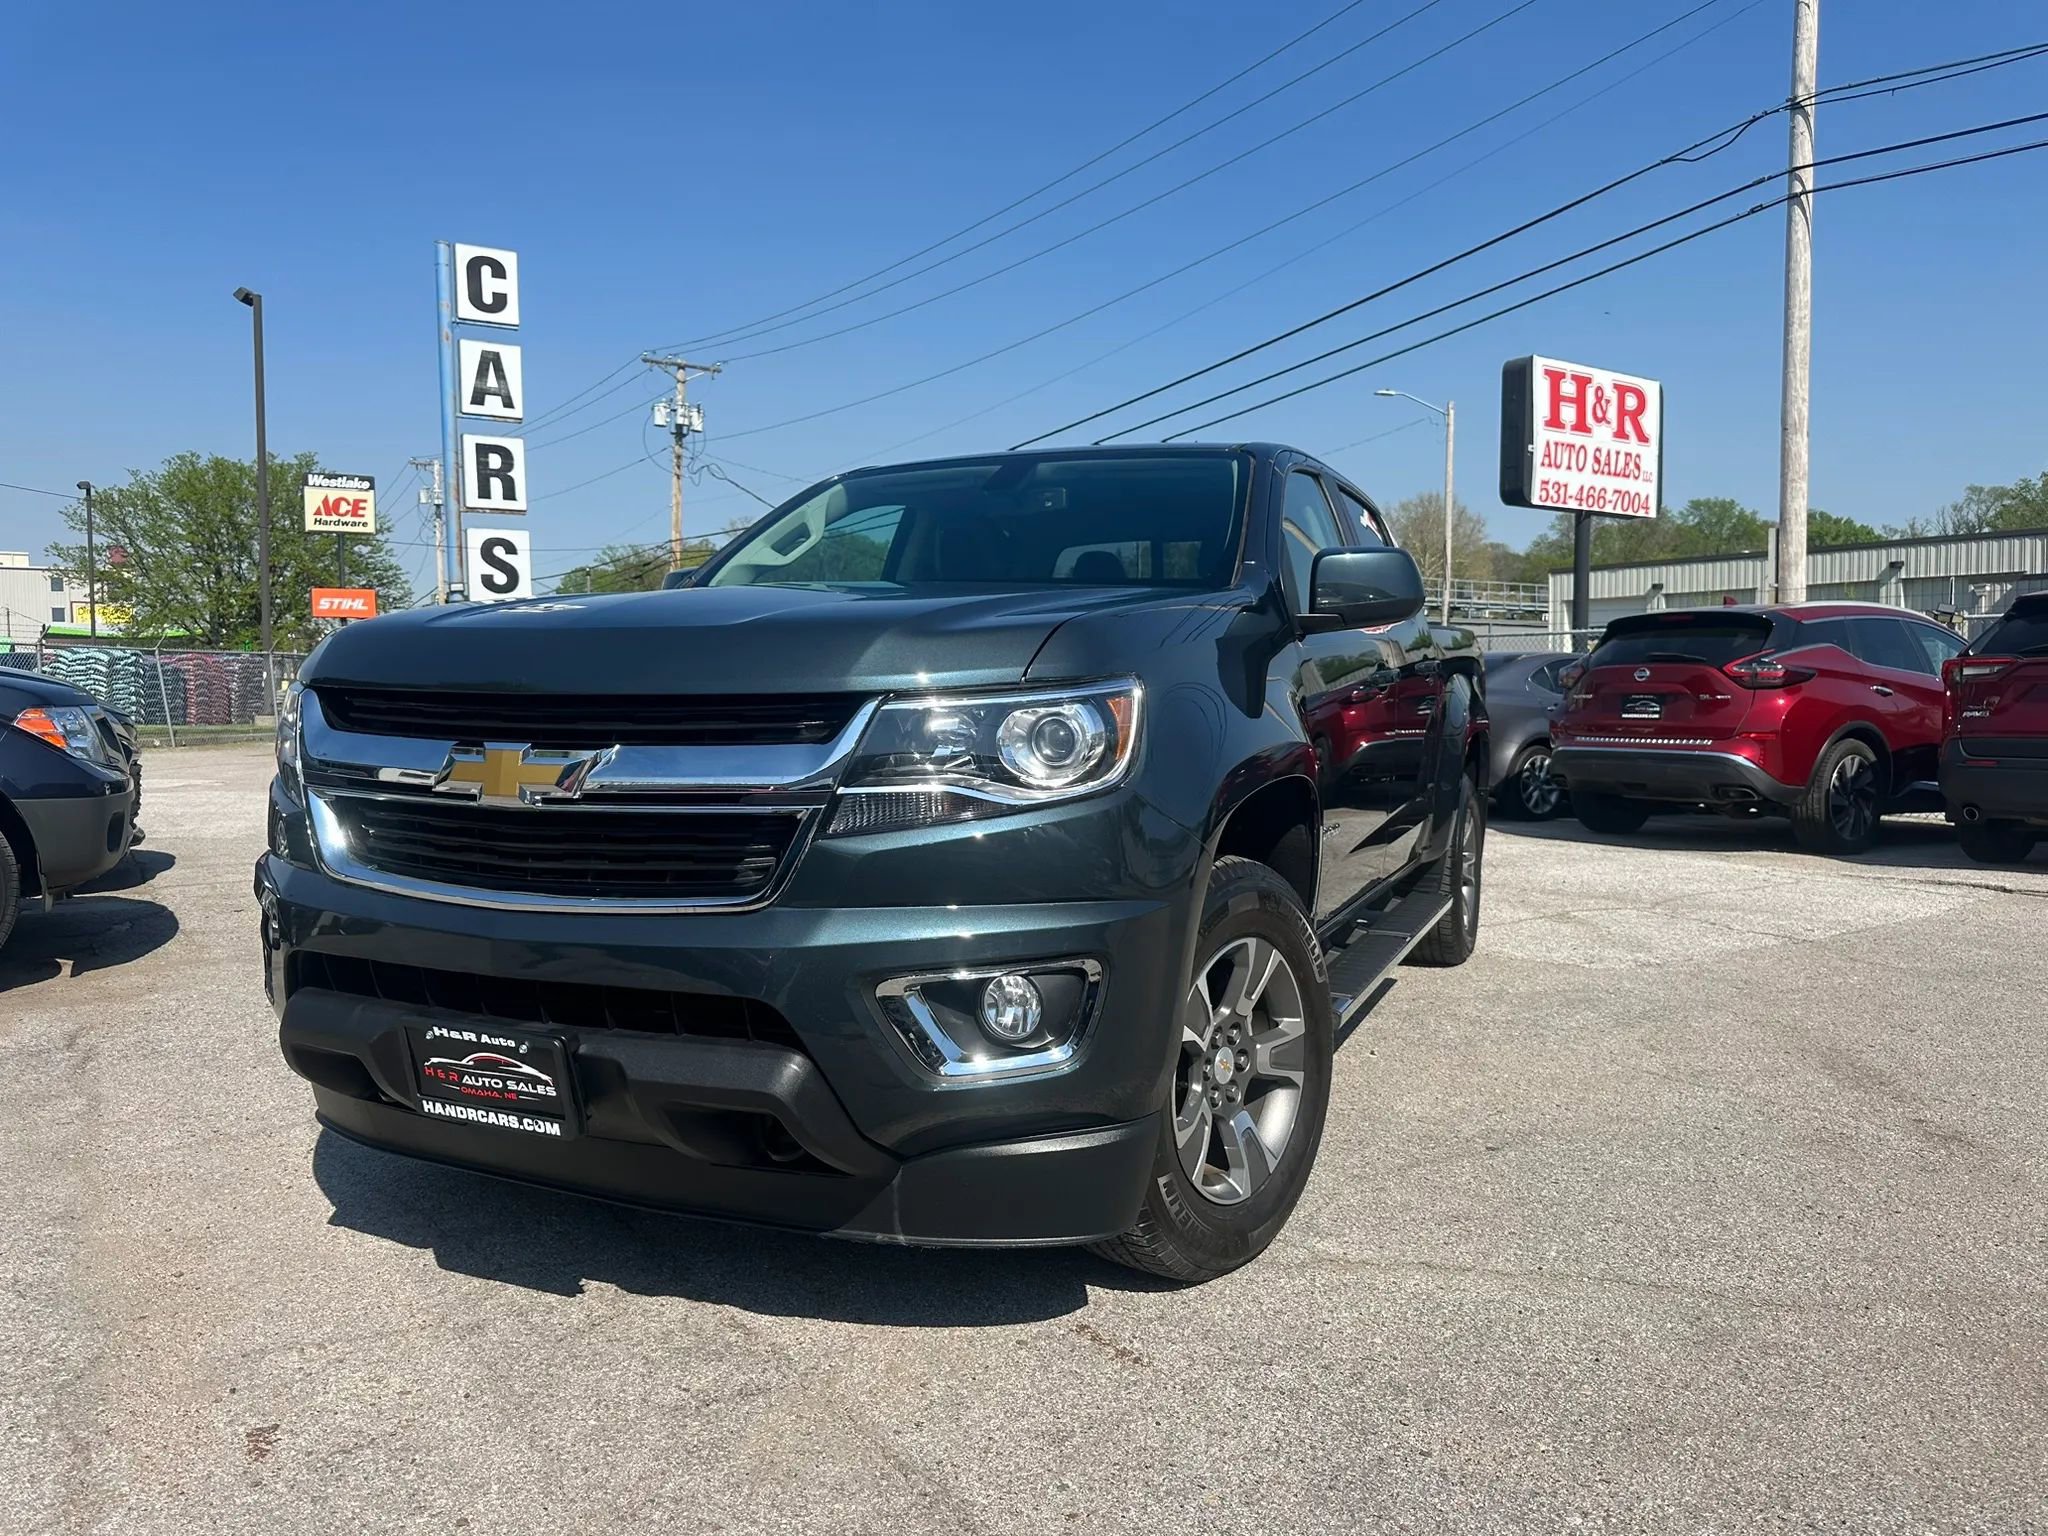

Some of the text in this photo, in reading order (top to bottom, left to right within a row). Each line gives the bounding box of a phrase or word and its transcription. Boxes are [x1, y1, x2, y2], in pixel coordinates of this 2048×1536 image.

[1543, 366, 1650, 445] H&R
[466, 255, 520, 594] CARS
[1540, 440, 1588, 472] AUTO
[1592, 447, 1641, 480] SALES
[307, 473, 371, 490] Westlake
[313, 493, 368, 518] ACE
[1538, 478, 1650, 515] 531-466-7004
[313, 517, 369, 528] Hardware
[318, 597, 369, 610] STIHL
[432, 1026, 516, 1048] H&R Auto
[424, 1066, 557, 1097] H & R AUTO SALES
[504, 1092, 518, 1100] NE
[422, 1100, 561, 1136] HANDRCARS.COM
